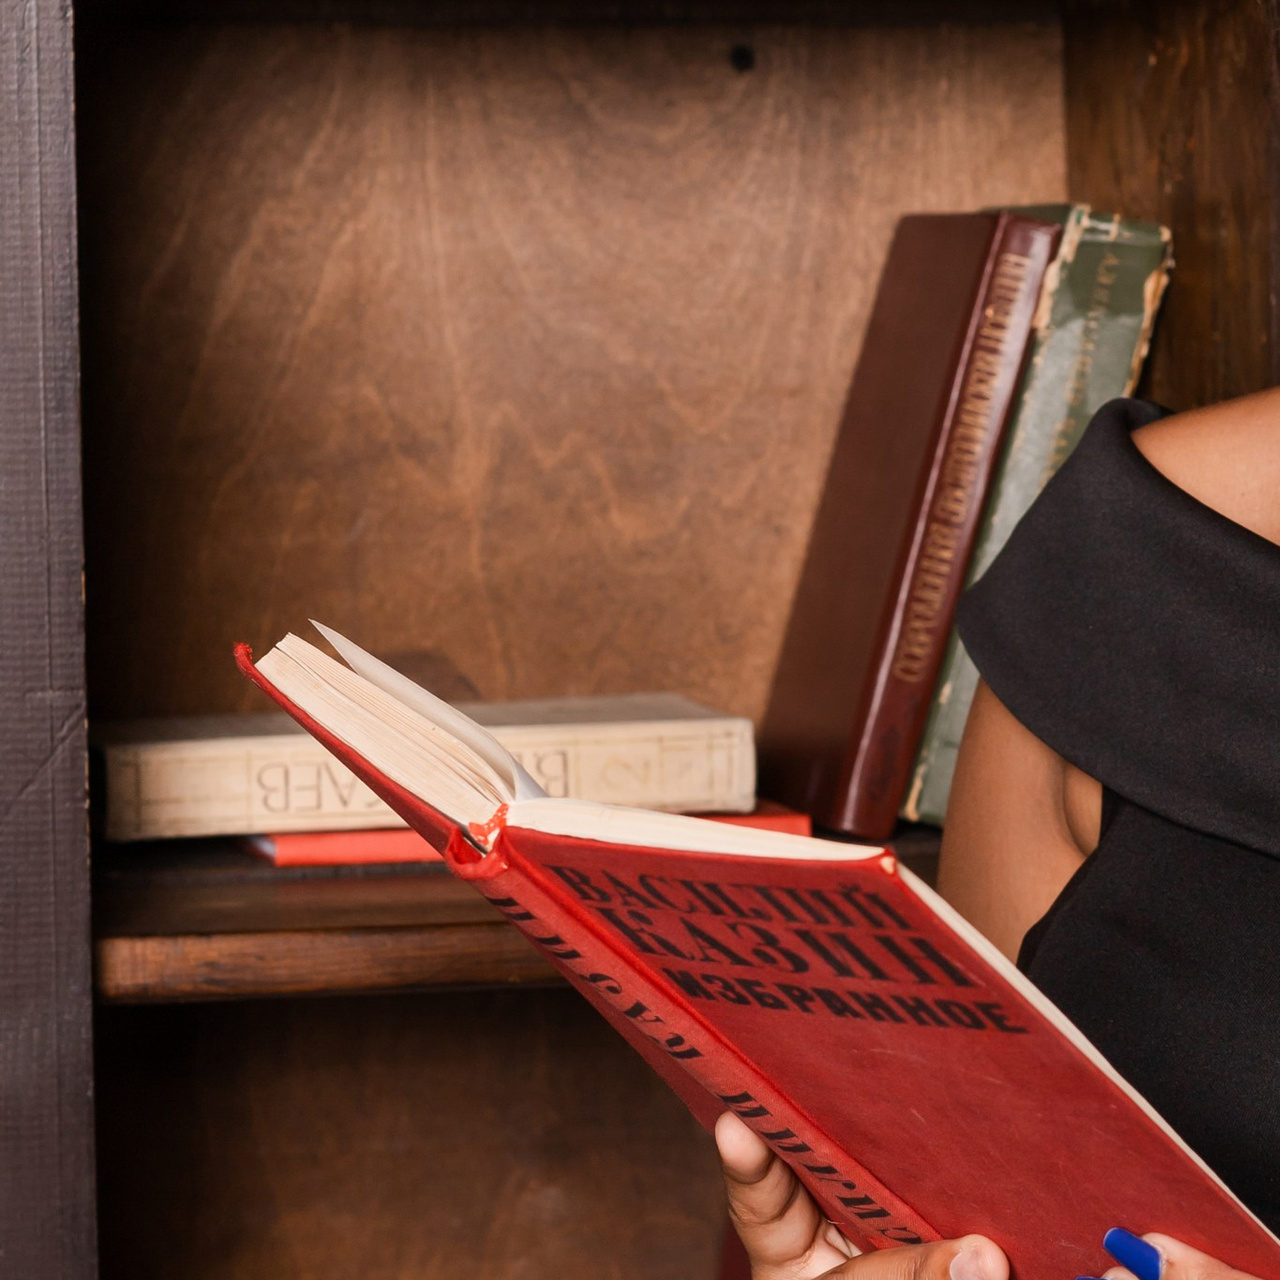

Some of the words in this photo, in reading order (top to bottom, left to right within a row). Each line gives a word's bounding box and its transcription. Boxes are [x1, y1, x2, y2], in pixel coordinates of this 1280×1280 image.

[542, 863, 912, 931] ВАСИЛИЙ
[594, 905, 981, 988] КАЗИН
[661, 966, 1030, 1035] ИЗБРАННОЕ
[717, 1090, 928, 1250] СИЛИЙ
